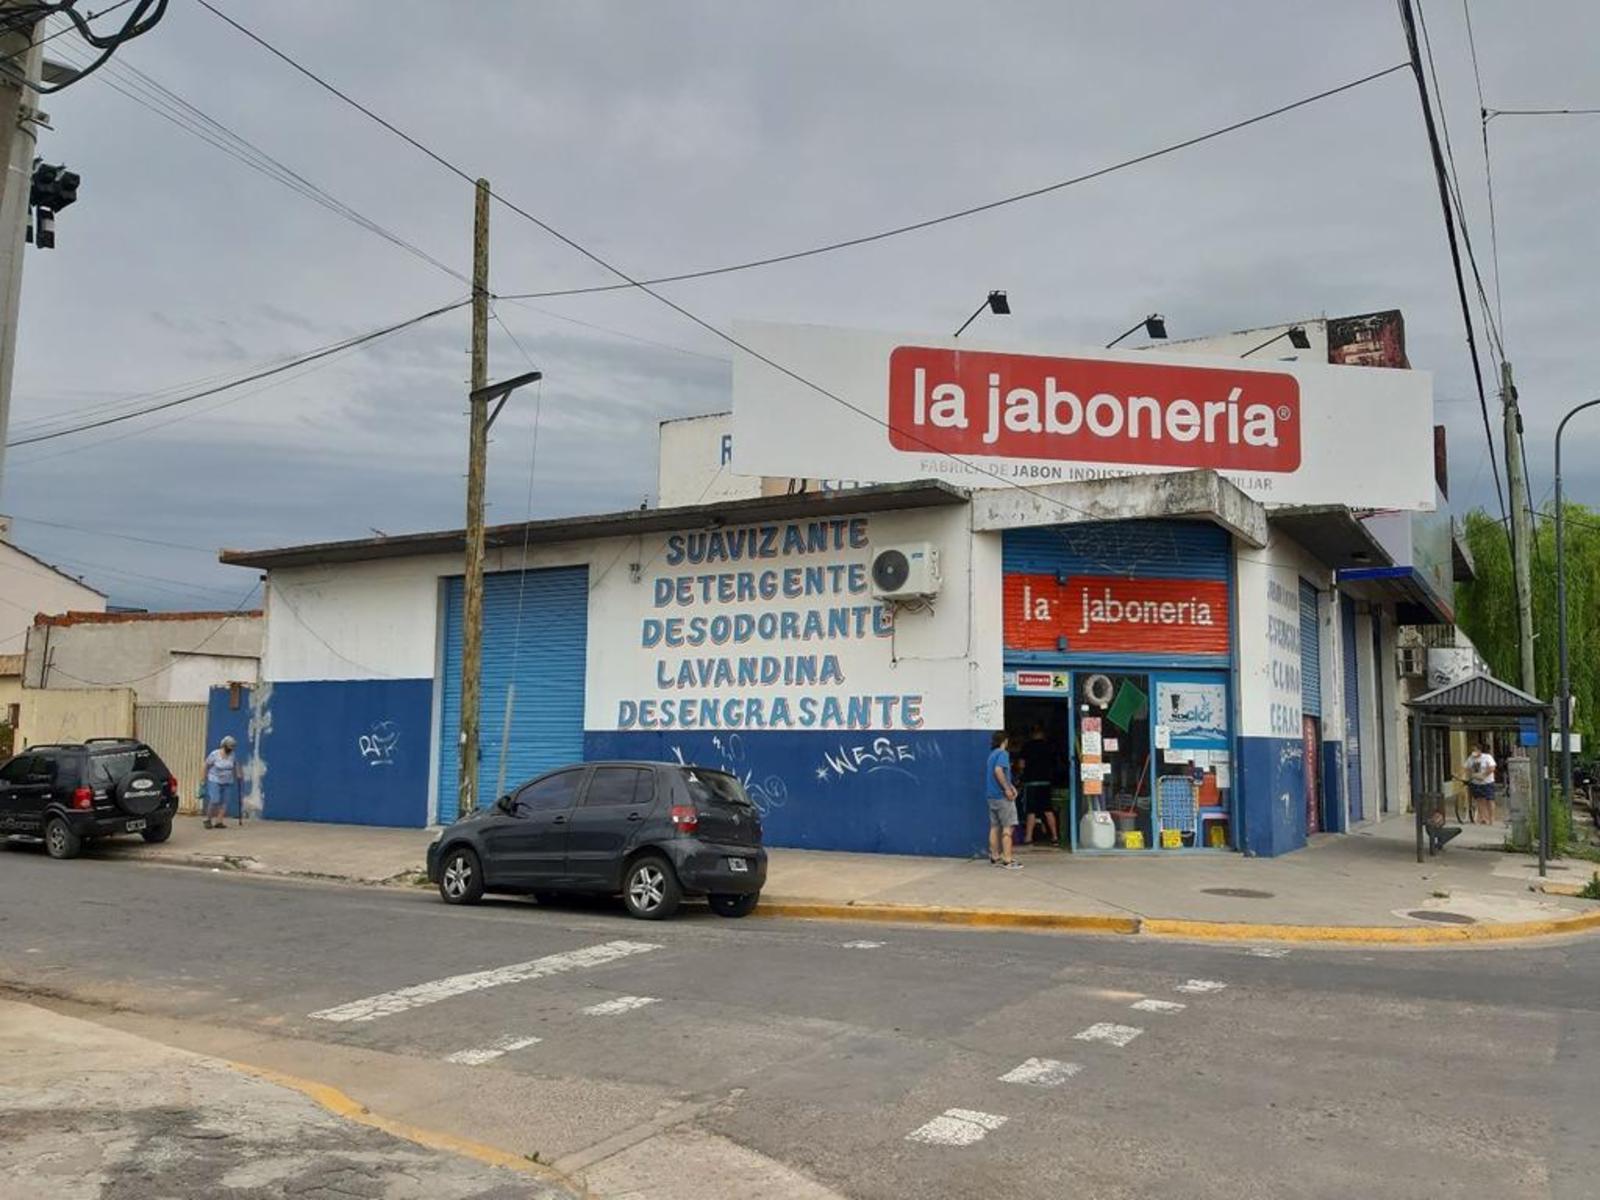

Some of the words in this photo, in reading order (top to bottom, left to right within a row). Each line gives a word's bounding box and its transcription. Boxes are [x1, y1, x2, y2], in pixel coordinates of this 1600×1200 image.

[912, 367, 968, 430] la
[982, 374, 1279, 447] jabonería
[1012, 464, 1062, 479] JABON
[666, 517, 870, 567] SUAVIZANTE
[654, 563, 870, 608] DETERGENTE
[1023, 584, 1053, 622] la
[641, 605, 896, 649] DESODORANTE
[656, 655, 846, 690] LAVANDINA
[617, 696, 925, 732] DESENGRASANTE
